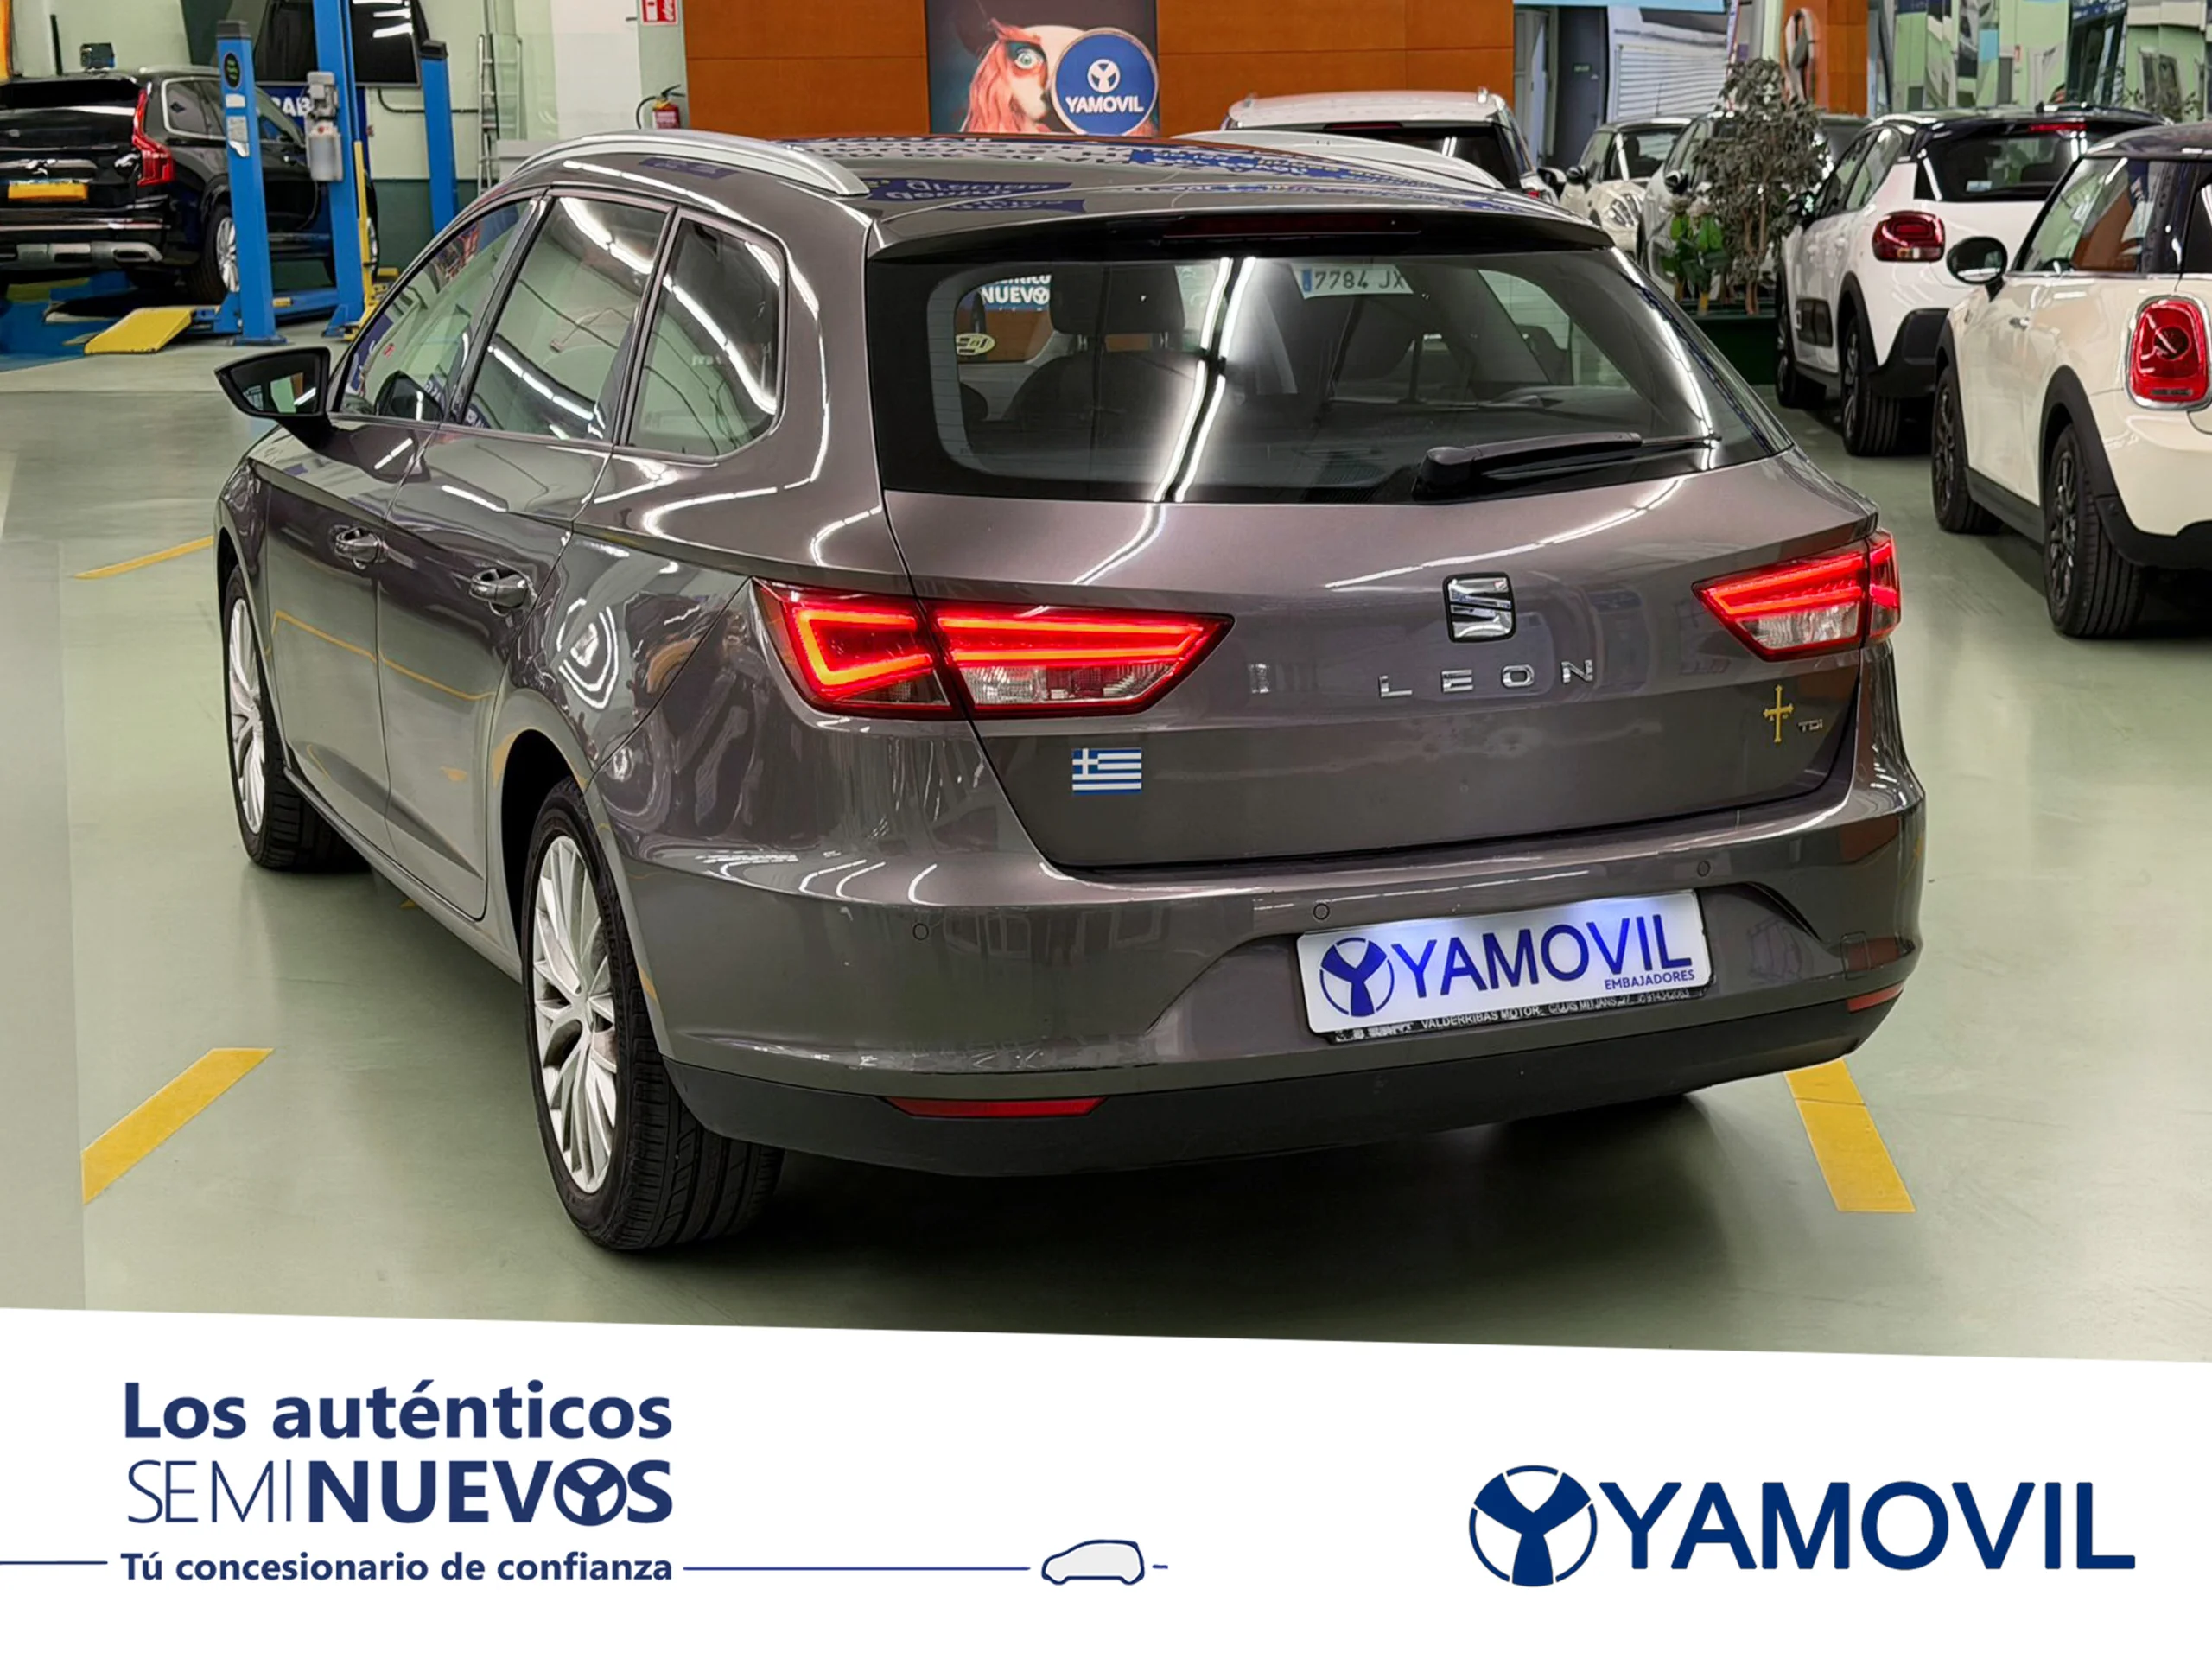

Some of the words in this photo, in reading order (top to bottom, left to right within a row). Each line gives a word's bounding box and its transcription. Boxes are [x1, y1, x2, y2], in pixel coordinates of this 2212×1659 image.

[1065, 96, 1144, 113] YAMOVIL
[1315, 270, 1369, 289] 7784
[1379, 659, 1592, 697] LEON
[1391, 914, 1692, 998] YAMOVIL
[1605, 969, 1694, 990] EMBAJADORES
[1421, 1010, 1498, 1029] VALDERRIBAS
